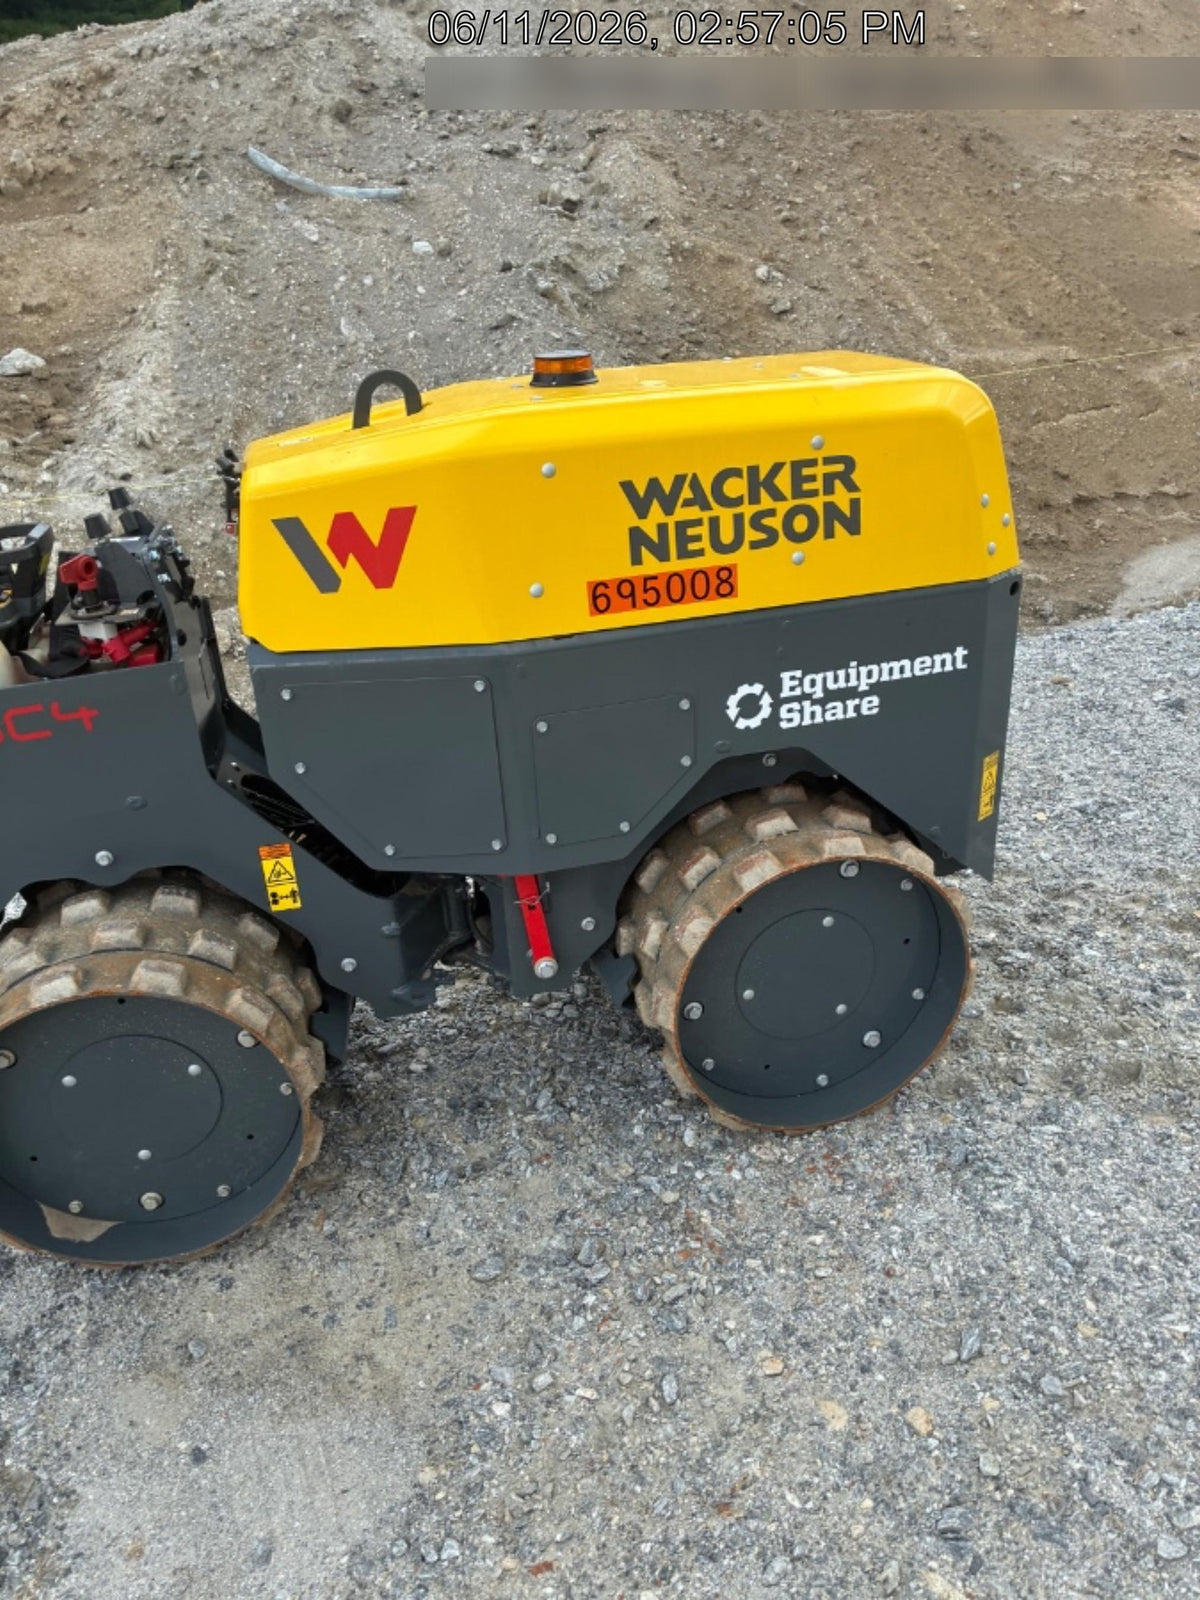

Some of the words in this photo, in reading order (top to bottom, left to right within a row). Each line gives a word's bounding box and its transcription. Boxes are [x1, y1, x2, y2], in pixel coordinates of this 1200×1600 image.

[618, 454, 861, 520] WACKER
[628, 497, 861, 566] NEUSON
[590, 566, 735, 615] 695008
[779, 645, 969, 700] Equipment
[0, 701, 99, 744] C4
[779, 694, 880, 730] Share
